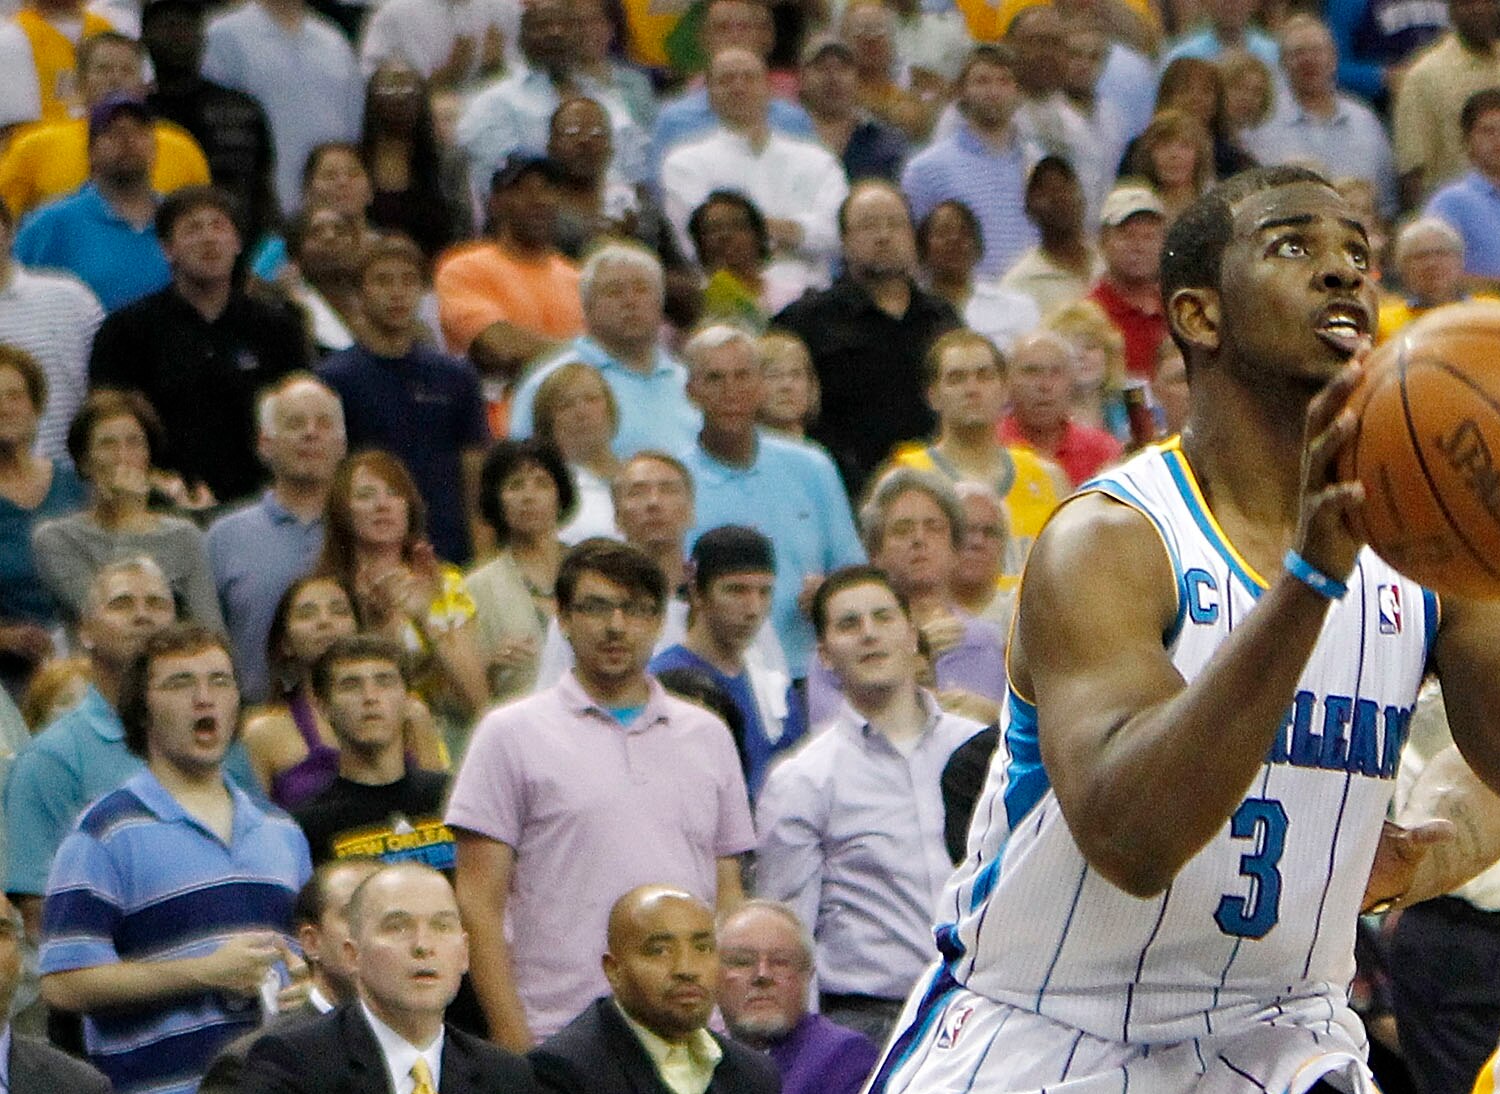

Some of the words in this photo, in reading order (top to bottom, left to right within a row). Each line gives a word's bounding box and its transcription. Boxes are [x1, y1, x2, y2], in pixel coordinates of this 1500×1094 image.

[1184, 568, 1219, 625] C
[1266, 690, 1416, 779] LEAN
[1213, 797, 1290, 940] 3
